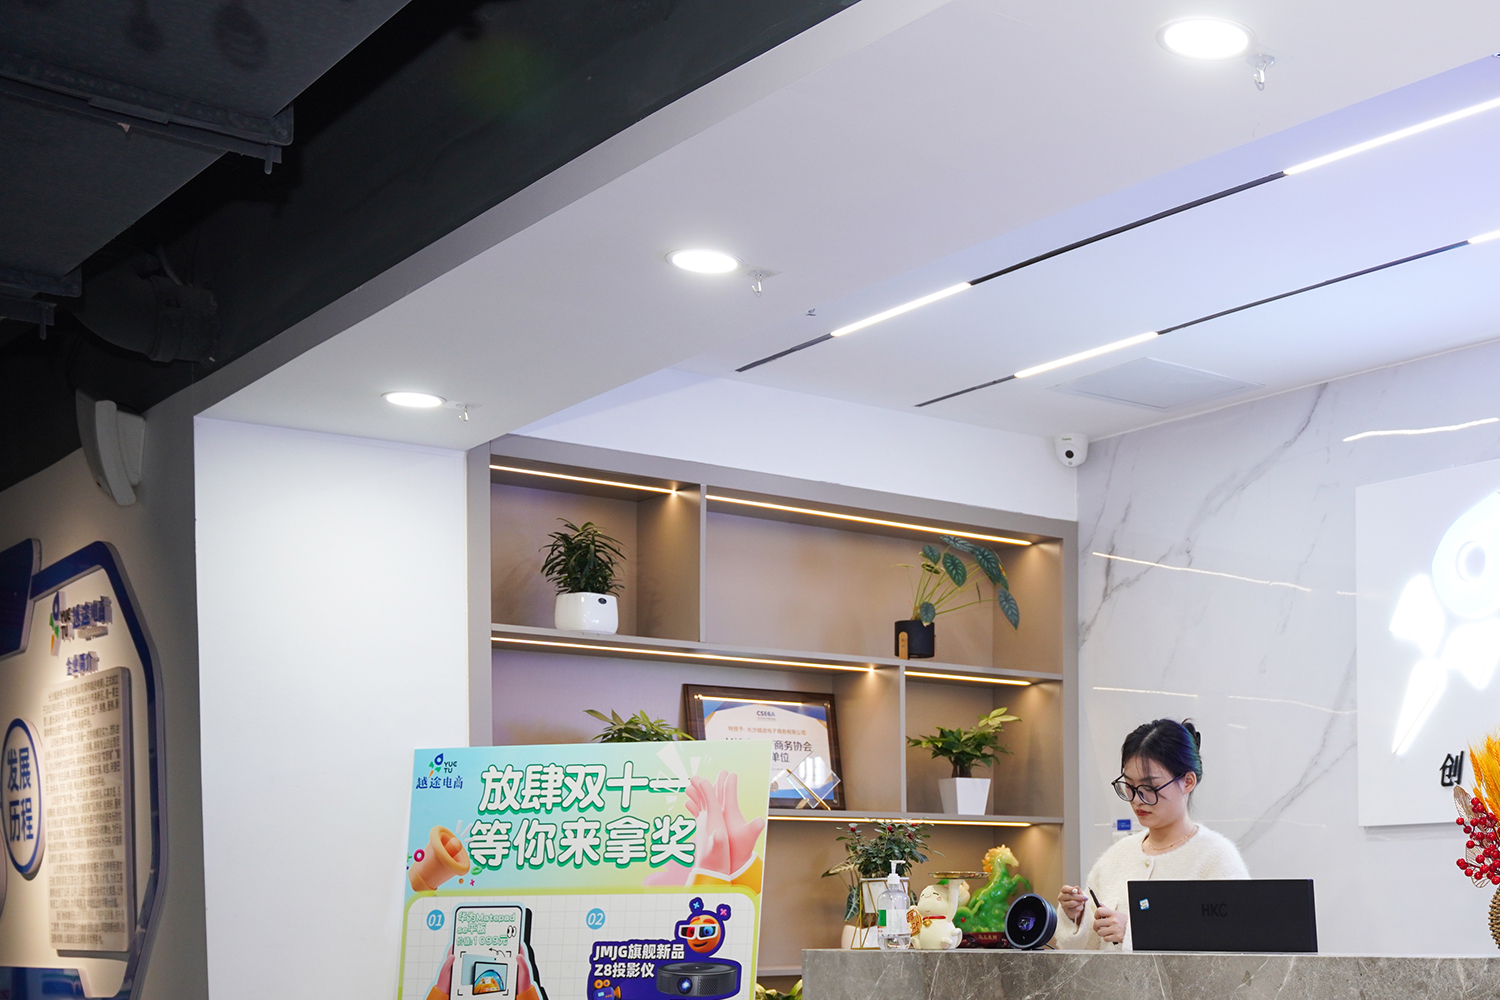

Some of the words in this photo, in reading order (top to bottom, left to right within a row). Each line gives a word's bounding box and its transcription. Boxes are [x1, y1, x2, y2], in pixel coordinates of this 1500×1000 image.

[7, 747, 31, 792] 发展
[416, 775, 463, 789] 越途电商
[478, 761, 692, 814] 放肆双十一
[9, 797, 34, 842] 历程
[468, 816, 698, 868] 等你来拿奖
[1201, 903, 1228, 918] HKC
[428, 914, 443, 927] 01
[587, 912, 605, 926] 02
[593, 944, 685, 960] JMJG旗舰新品
[594, 962, 655, 978] Z8投影仪
